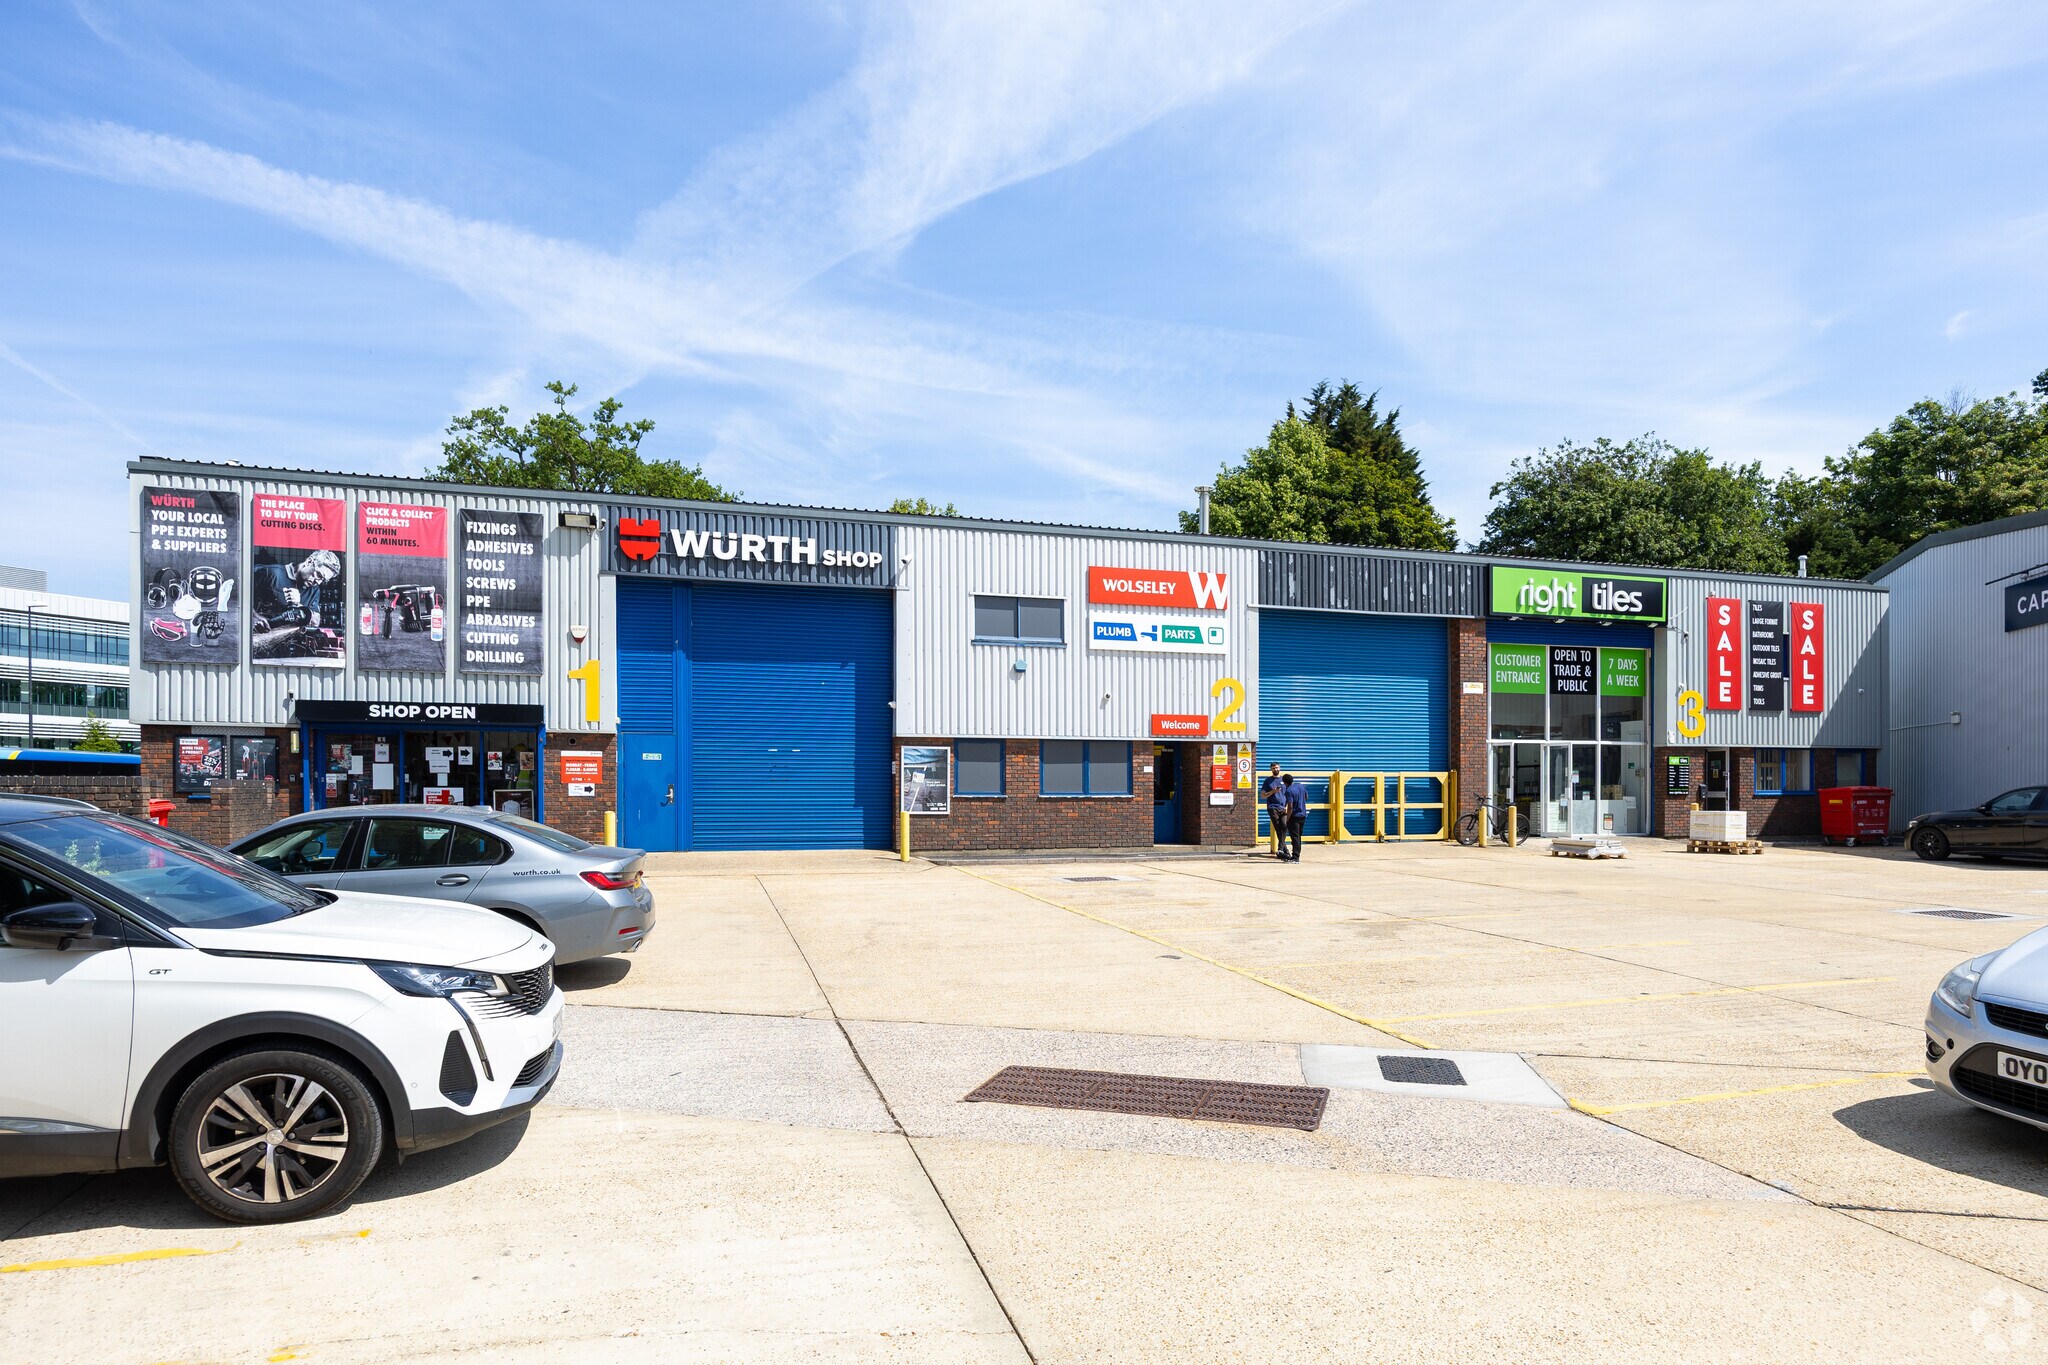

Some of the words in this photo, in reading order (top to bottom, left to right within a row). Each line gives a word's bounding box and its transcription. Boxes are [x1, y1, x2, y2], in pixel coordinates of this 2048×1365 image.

[151, 494, 195, 508] WÜRTH
[260, 499, 276, 508] THE
[279, 500, 305, 510] PLACE
[151, 510, 185, 523] YOUR
[187, 512, 224, 525] LOCAL
[260, 508, 272, 518] TO
[274, 509, 292, 519] BUY
[294, 511, 318, 521] YOUR
[366, 507, 389, 517] CLICK
[391, 508, 398, 517] &
[400, 509, 433, 519] COLLECT
[260, 519, 297, 529] CUTTING
[299, 521, 326, 532] DISCS.
[366, 517, 410, 528] PRODUCTS
[466, 521, 517, 536] FIXINGS
[151, 525, 175, 537] PPE
[177, 526, 227, 539] EXPERTS
[366, 527, 397, 536] WITHIN
[151, 539, 162, 551] &
[165, 540, 227, 553] SUPPLIERS
[366, 536, 378, 546] 60
[380, 537, 420, 548] MINUTES.
[466, 540, 534, 555] ADHESIVES
[670, 528, 816, 565] WÜRTH
[822, 549, 883, 568] SHOP
[466, 558, 505, 572] TOOLS
[466, 576, 516, 591] SCREWS
[1102, 579, 1176, 595] WOLSELEY
[466, 595, 491, 608] PPE
[1519, 577, 1577, 612] right
[1591, 581, 1643, 613] tiles
[2017, 589, 2048, 614] CAP
[466, 613, 536, 628] ABRASIVES
[466, 631, 519, 646] CUTTING
[1097, 626, 1132, 637] PLUMB
[1164, 629, 1196, 640] PARTS
[1752, 631, 1774, 639] BATHROOMS
[466, 650, 525, 664] DRILLING
[1495, 653, 1541, 667] CUSTOMER
[1554, 649, 1577, 662] OPEN
[1580, 650, 1591, 662] TO
[1717, 605, 1732, 702] SALE
[1800, 610, 1816, 705] SALE
[1608, 658, 1614, 669] 7
[1617, 659, 1638, 671] DAYS
[1767, 658, 1776, 666] TILES
[1495, 671, 1540, 684] ENTRANCE
[1553, 664, 1582, 677] TRADE
[1584, 666, 1592, 678] &
[1557, 679, 1588, 692] PUBLIC
[1606, 674, 1613, 685] A
[1616, 675, 1639, 687] WEEK
[568, 659, 600, 722] 1
[1211, 677, 1246, 732] 2
[368, 704, 421, 719] SHOP
[424, 705, 476, 720] OPEN
[1677, 690, 1706, 738] 3
[1161, 720, 1200, 730] Welcome
